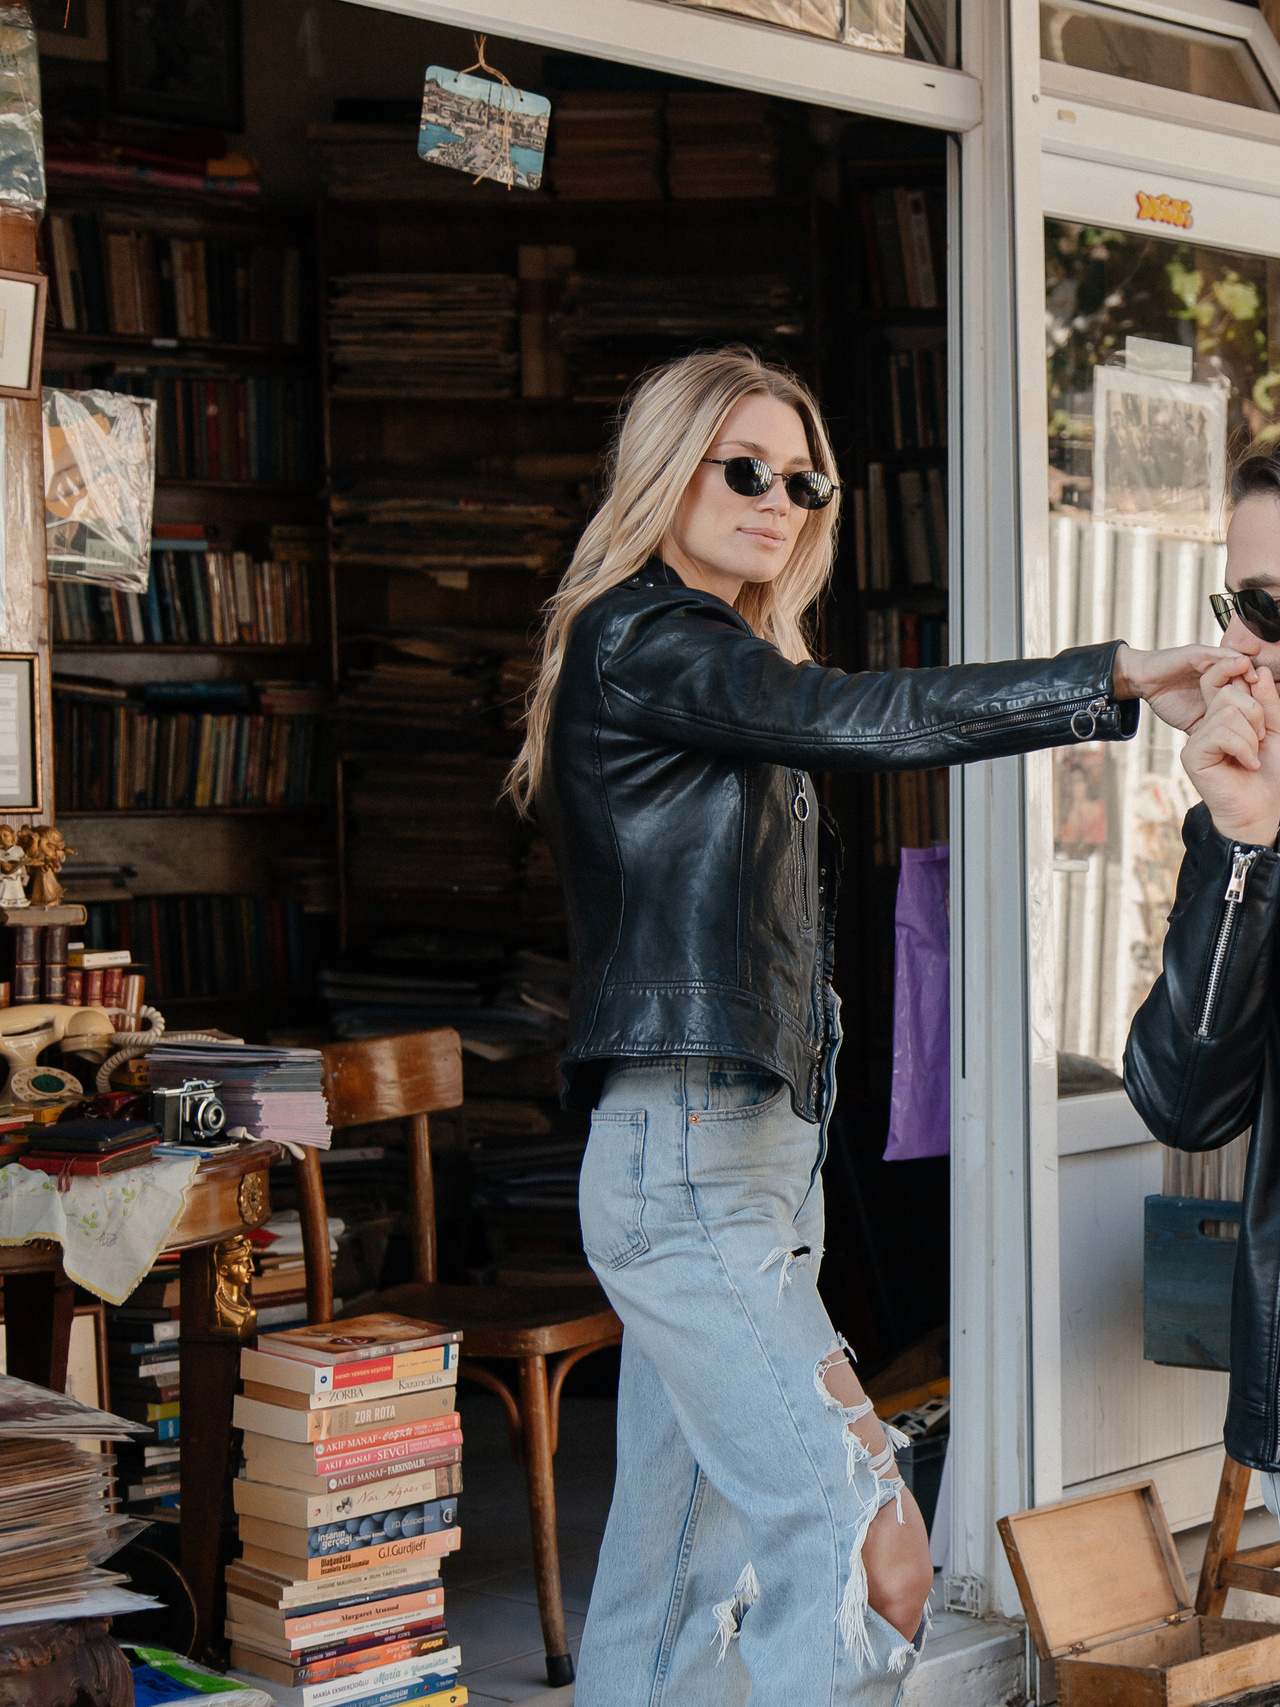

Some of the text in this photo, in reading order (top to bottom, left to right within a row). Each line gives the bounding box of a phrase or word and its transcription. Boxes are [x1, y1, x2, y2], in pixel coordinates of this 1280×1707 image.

[329, 1375, 443, 1402] ZORBA Kazancakis
[355, 1407, 372, 1425] ZOR
[375, 1405, 396, 1421] ROTA
[325, 1438, 346, 1452] AKİF
[325, 1459, 343, 1471] AKİF
[345, 1453, 372, 1467] MANAF
[338, 1473, 355, 1487] AKİF
[322, 1534, 352, 1550] gerçeği
[321, 1554, 351, 1568] Olağanüstü
[341, 1609, 373, 1622] Margaret
[375, 1603, 400, 1614] Atwood
[374, 1669, 401, 1685] Maria
[313, 1689, 331, 1700] MARİA
[379, 1689, 409, 1703] DÖNÜŞÜM
